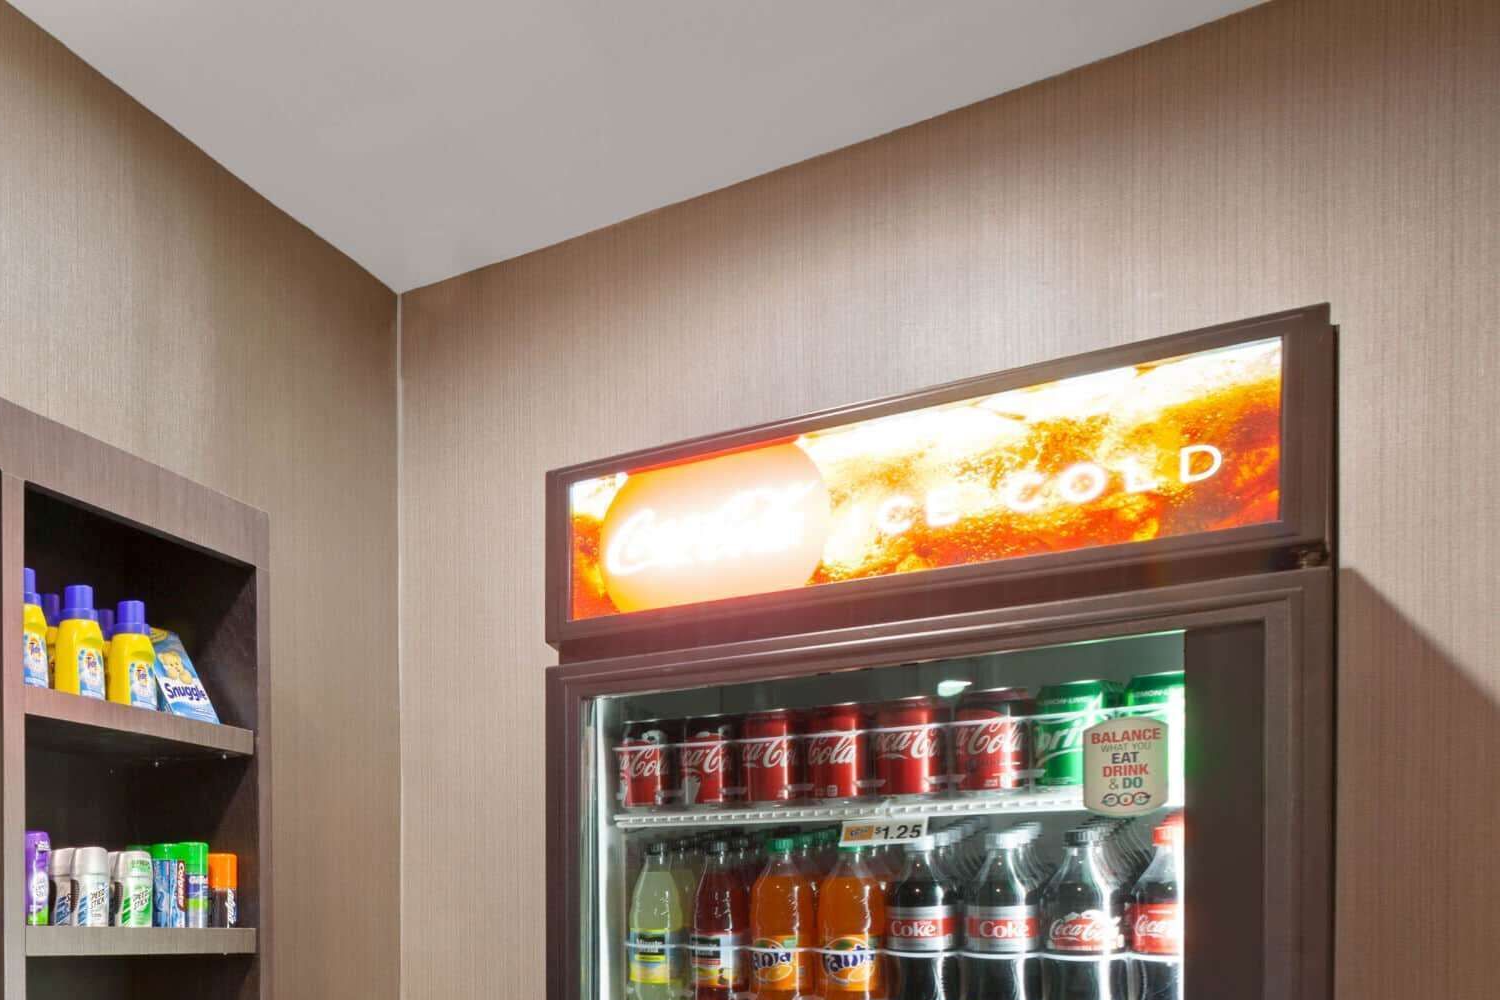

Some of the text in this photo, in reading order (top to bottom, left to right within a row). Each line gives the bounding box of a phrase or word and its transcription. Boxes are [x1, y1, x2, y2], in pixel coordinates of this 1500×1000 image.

[164, 683, 207, 701] Snuggle
[1091, 727, 1162, 745] BALANCE
[1100, 739, 1153, 753] WHAT YOU
[1111, 751, 1139, 765] EAT
[1103, 763, 1149, 777] DRINK
[1109, 777, 1143, 790] & DO
[875, 824, 922, 840] $1.25
[891, 919, 938, 938] Coke
[979, 919, 1029, 938] Coke
